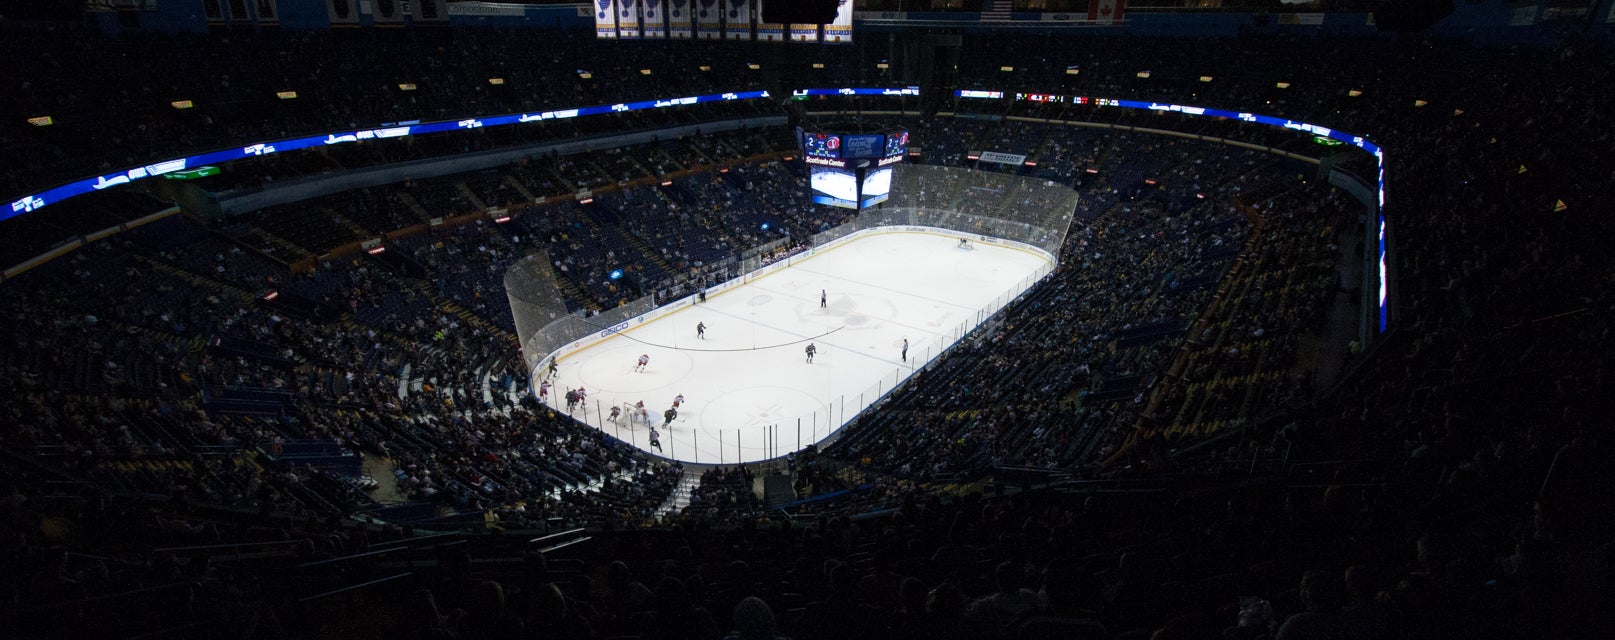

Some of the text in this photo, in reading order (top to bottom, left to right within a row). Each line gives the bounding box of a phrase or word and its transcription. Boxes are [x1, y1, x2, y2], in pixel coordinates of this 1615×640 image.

[808, 138, 814, 146] 2
[806, 156, 845, 167] Scottrade Center
[601, 322, 629, 337] GEICO
